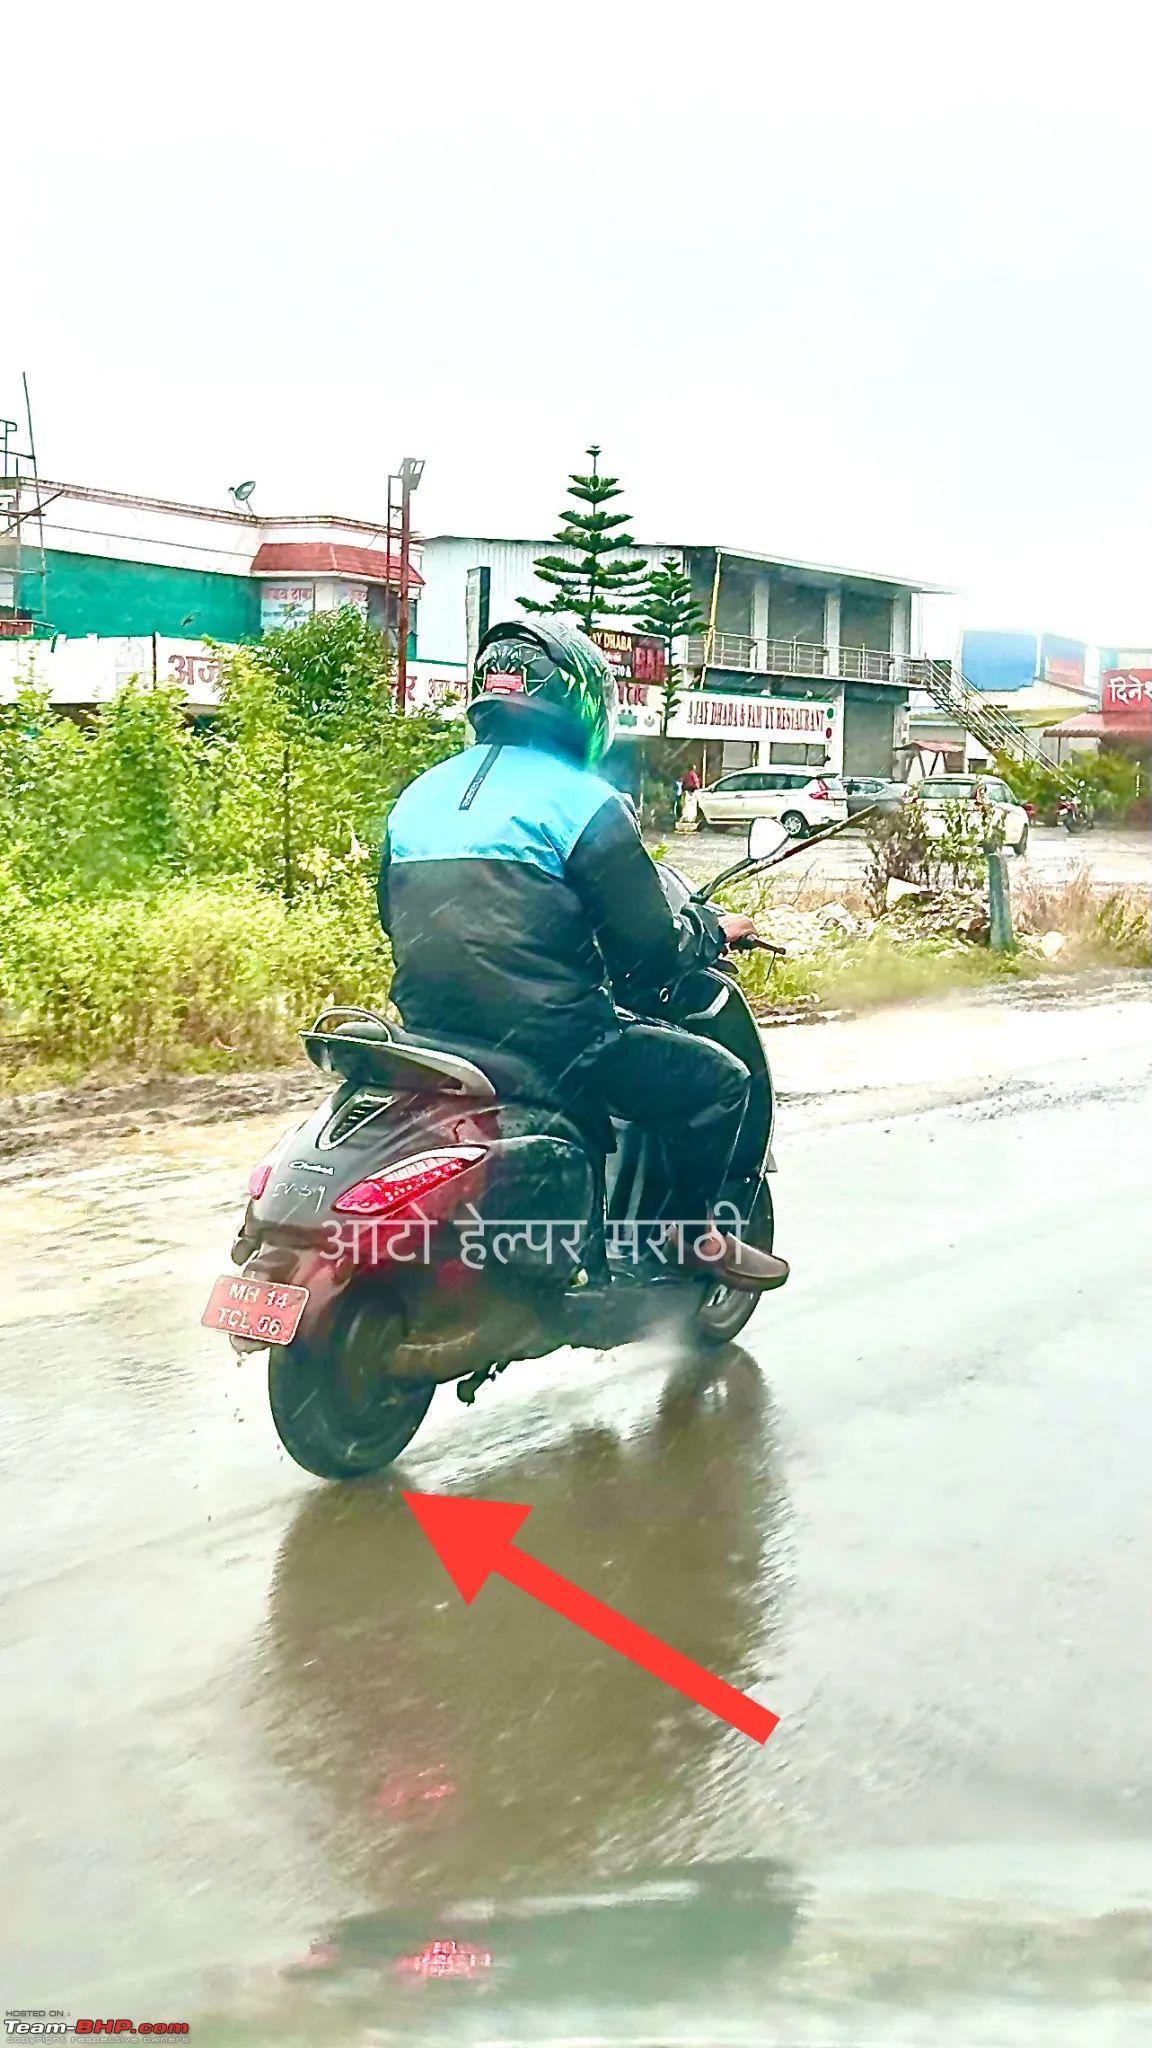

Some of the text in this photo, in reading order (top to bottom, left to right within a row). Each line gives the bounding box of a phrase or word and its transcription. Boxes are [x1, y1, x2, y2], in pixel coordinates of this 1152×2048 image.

[710, 701, 738, 727] DHABA
[776, 707, 825, 732] RESTAURANT
[228, 1282, 289, 1310] MH 14
